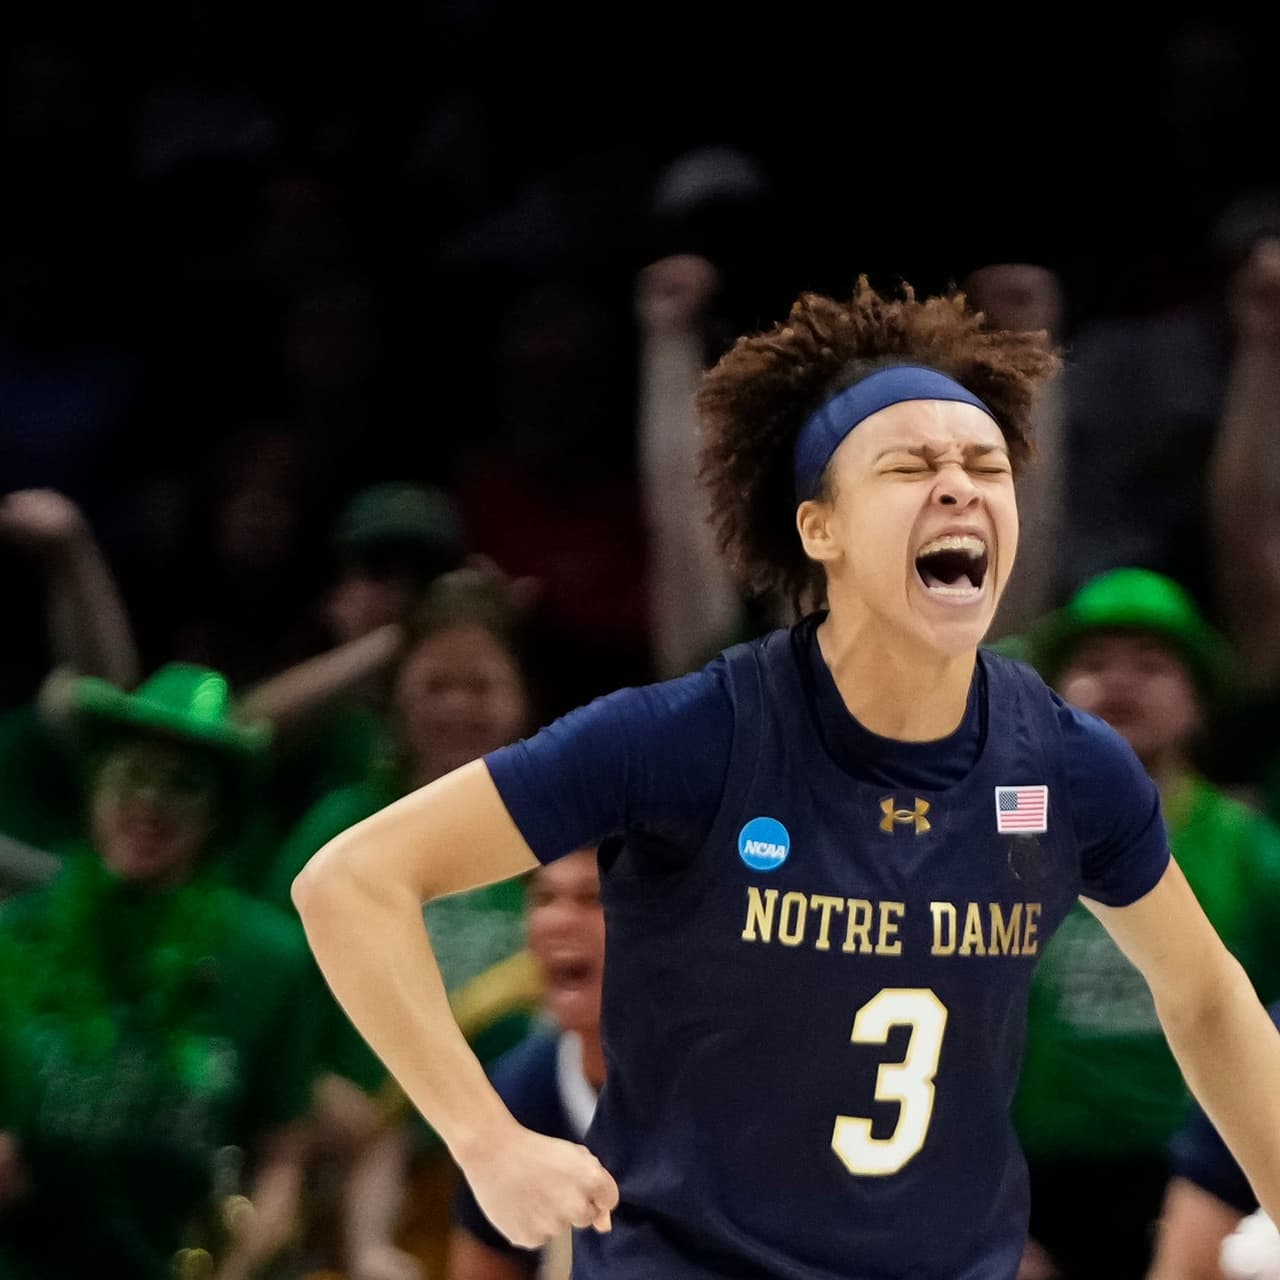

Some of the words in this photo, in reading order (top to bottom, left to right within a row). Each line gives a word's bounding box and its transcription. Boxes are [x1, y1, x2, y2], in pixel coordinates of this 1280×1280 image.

[744, 839, 787, 859] NCAA
[741, 885, 906, 957] NOTRE
[930, 900, 1042, 957] DAME
[830, 986, 949, 1177] 3
